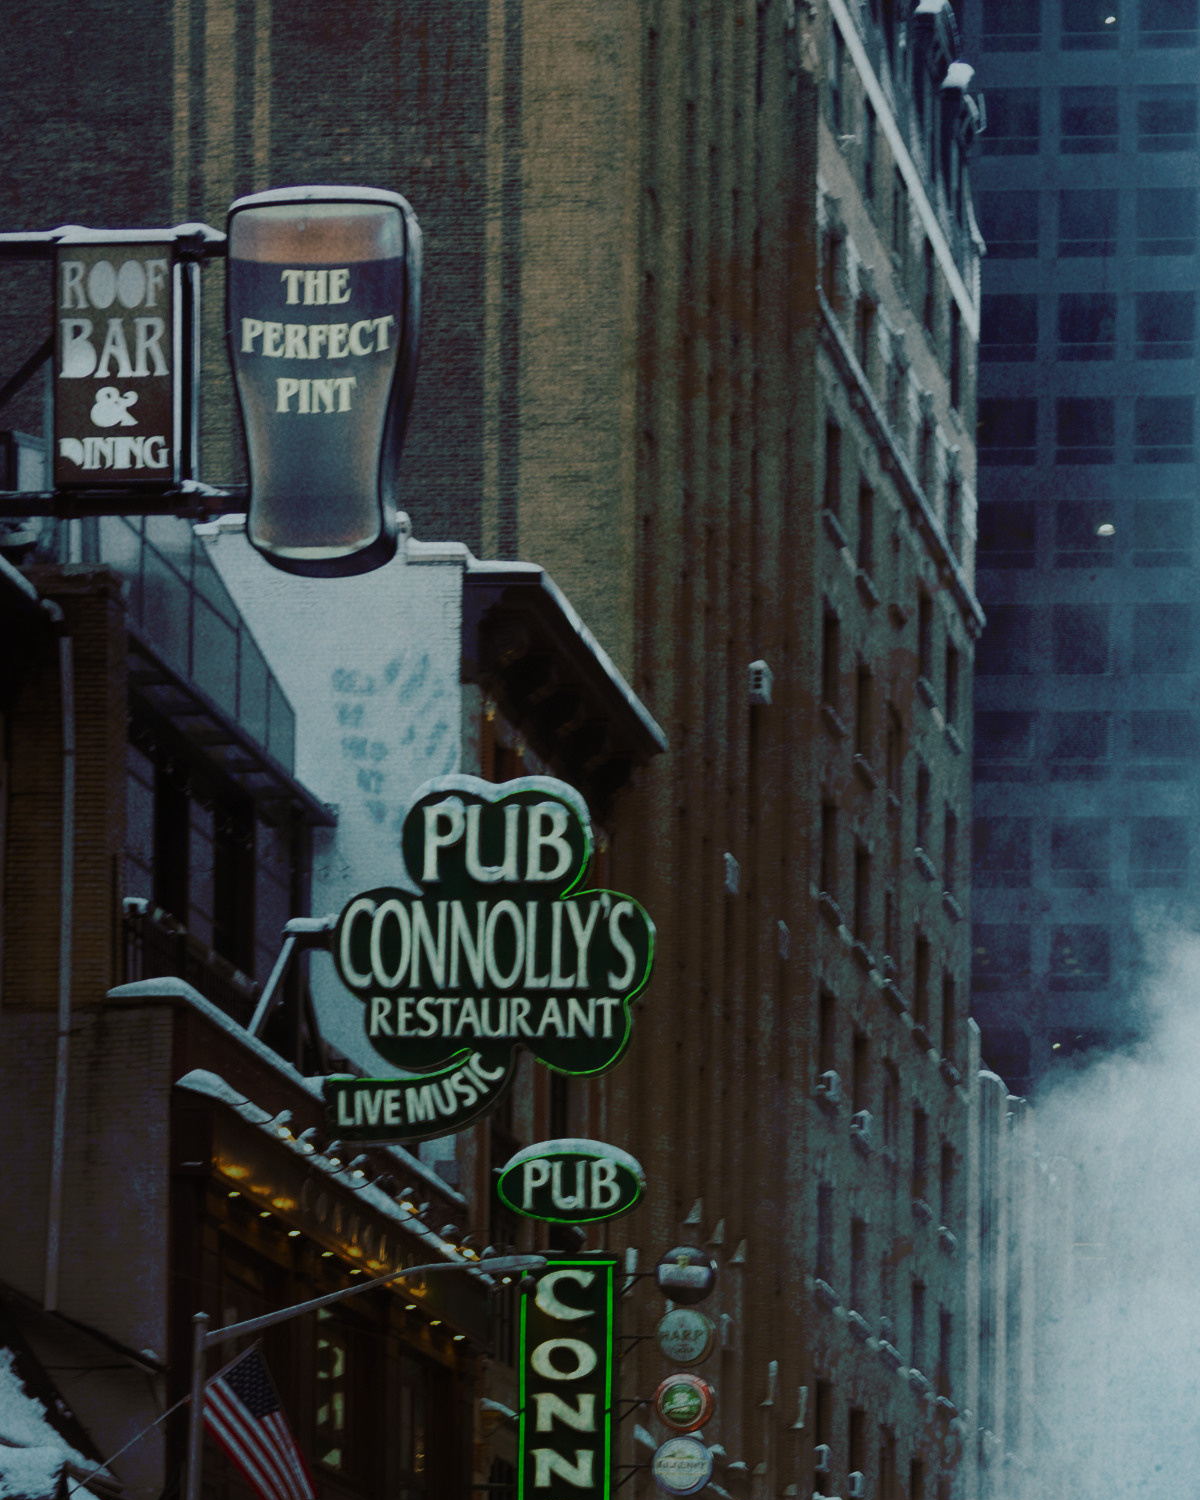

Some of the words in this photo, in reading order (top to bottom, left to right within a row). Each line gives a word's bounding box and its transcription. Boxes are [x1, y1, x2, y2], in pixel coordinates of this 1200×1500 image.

[60, 258, 168, 310] ROOF
[281, 268, 351, 305] THE
[59, 317, 169, 379] BAR
[241, 315, 394, 360] PERFECT
[90, 386, 138, 427] &
[275, 377, 356, 414] PINT
[58, 435, 169, 471] DINING
[421, 796, 575, 883] PUB
[340, 894, 636, 990] CONNOLLY'S
[368, 996, 622, 1040] RESTAURANT
[336, 1088, 401, 1128] LIVE
[405, 1051, 506, 1125] MUSIC
[522, 1158, 622, 1210] PUB
